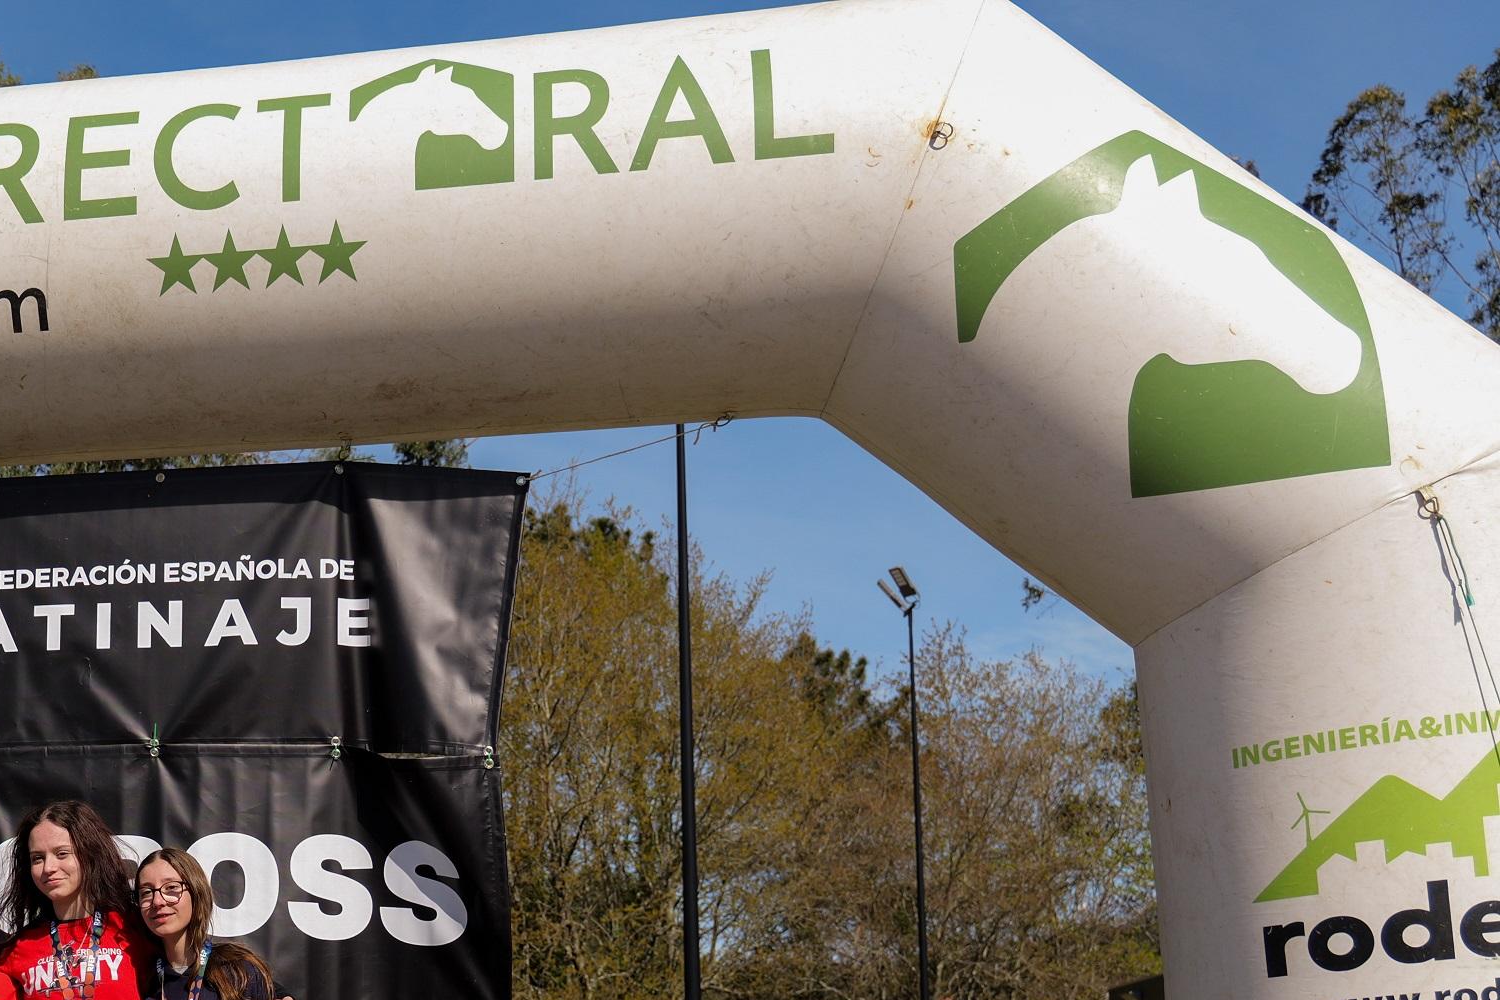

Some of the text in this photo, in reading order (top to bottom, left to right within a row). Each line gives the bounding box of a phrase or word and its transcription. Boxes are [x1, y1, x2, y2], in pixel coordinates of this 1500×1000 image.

[164, 555, 312, 584] ESPAÑOLA
[319, 559, 355, 581] DE
[1232, 709, 1500, 768] INGENIERÍA&INM
[1263, 879, 1500, 978] rode
